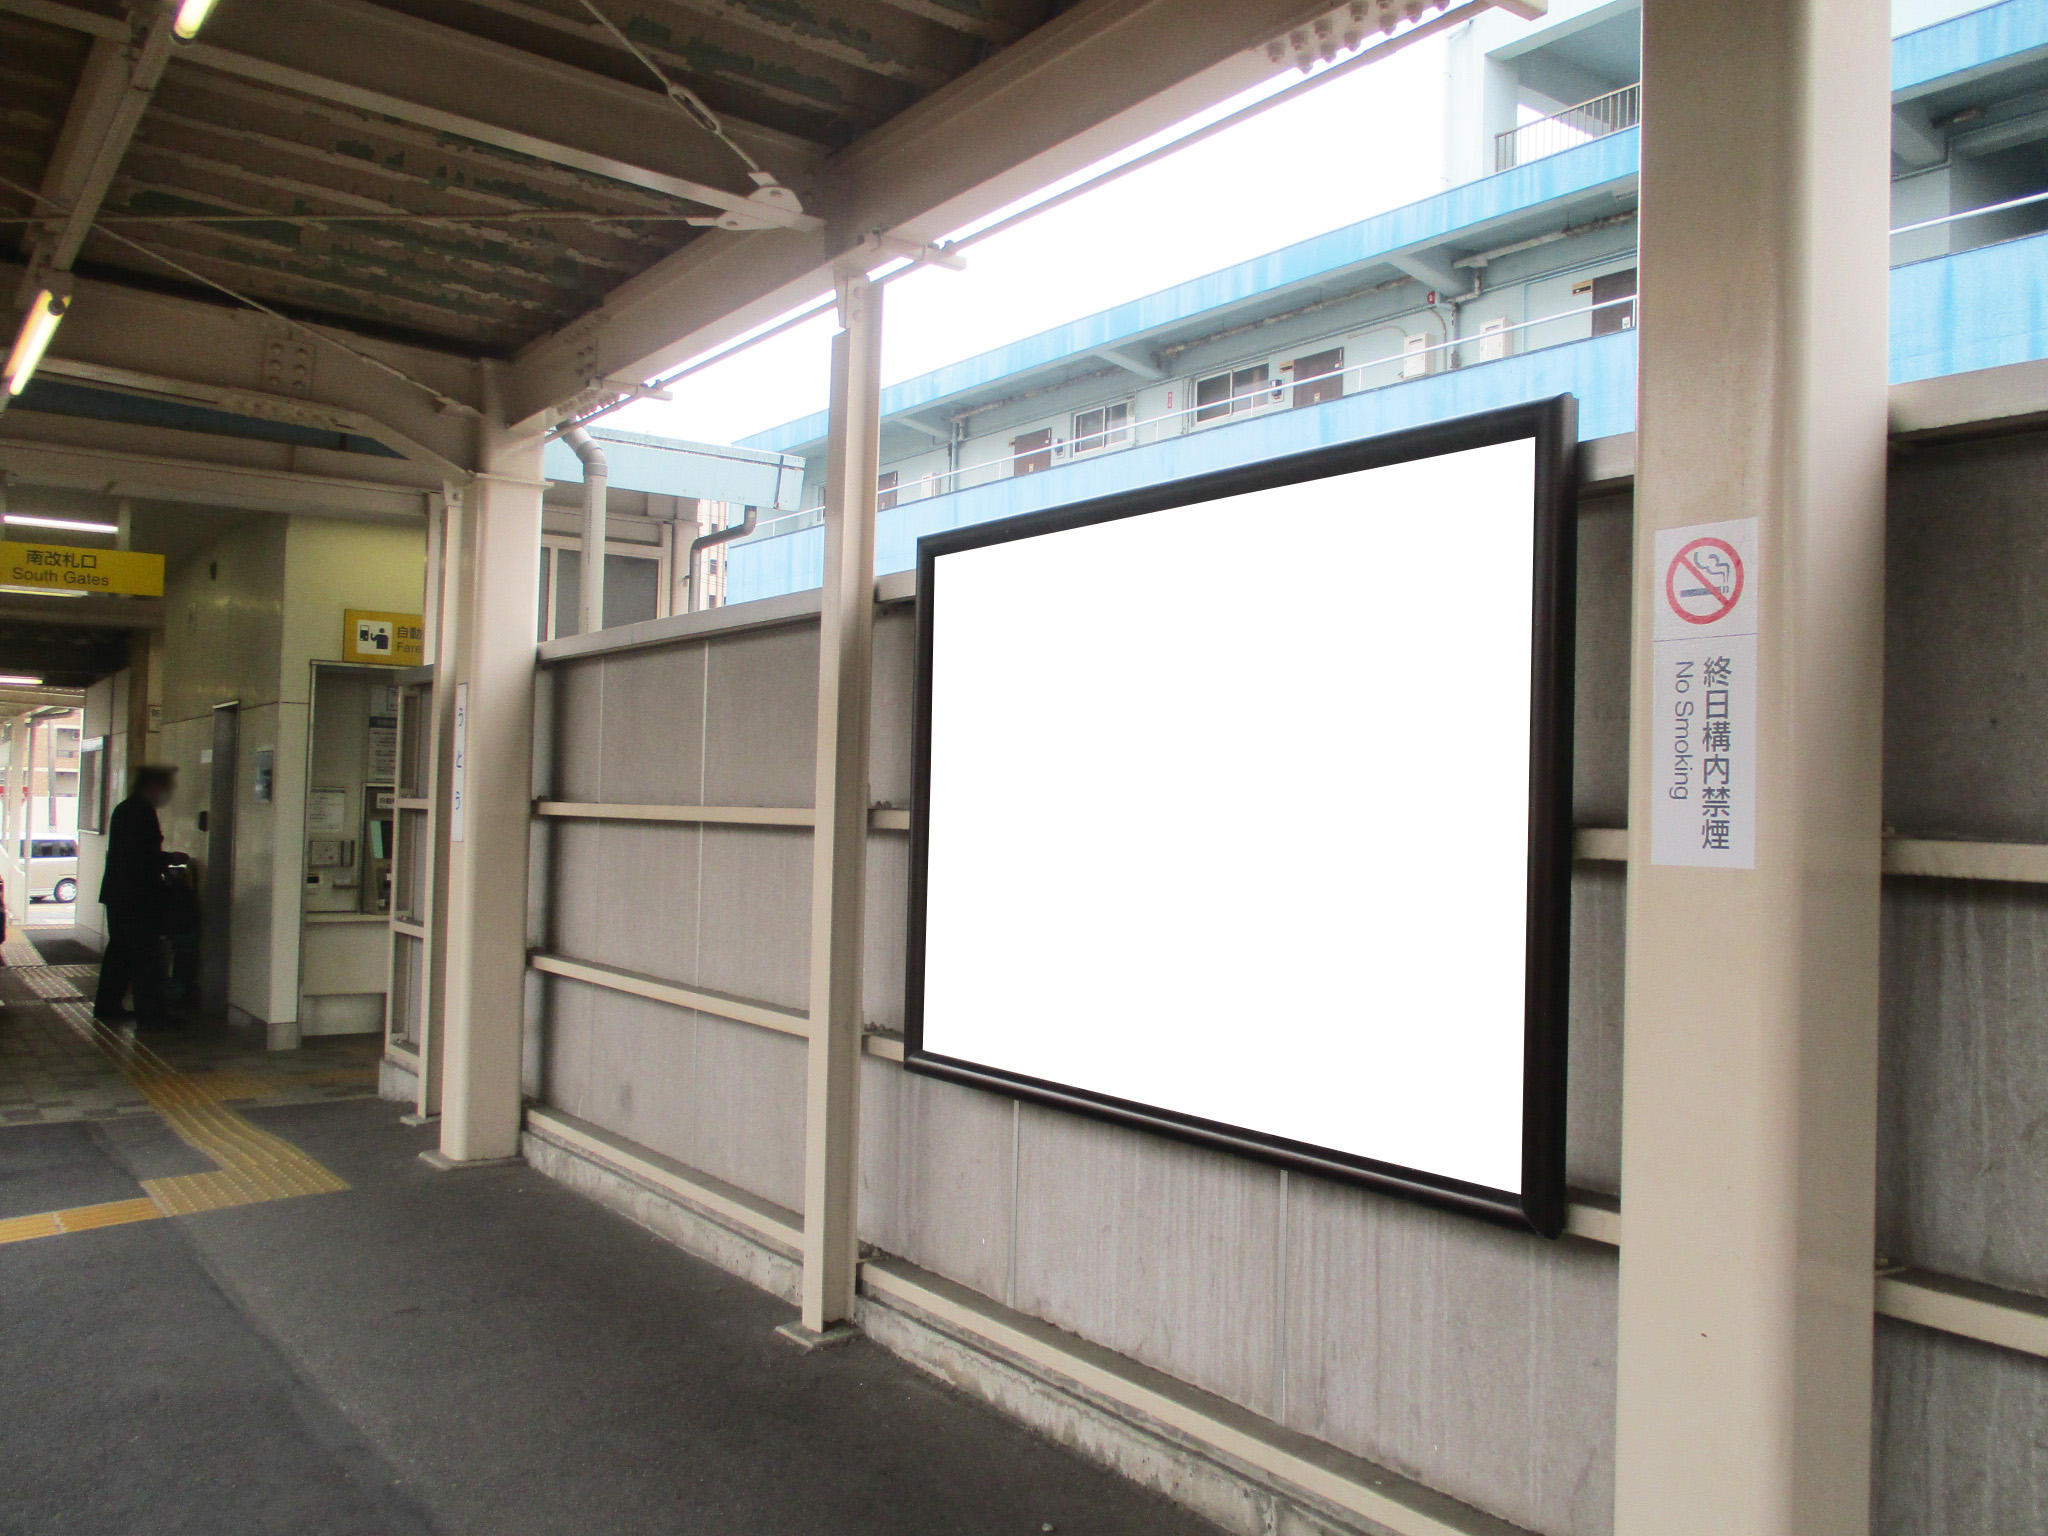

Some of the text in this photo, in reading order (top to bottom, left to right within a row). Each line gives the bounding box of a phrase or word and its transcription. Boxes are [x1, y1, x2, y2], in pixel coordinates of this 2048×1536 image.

[26, 549, 98, 569] 南改札口
[12, 567, 110, 587] South Gates
[397, 641, 422, 654] Fare
[1668, 660, 1695, 801] No Smoking
[1701, 655, 1733, 851] 終日構内禁煙
